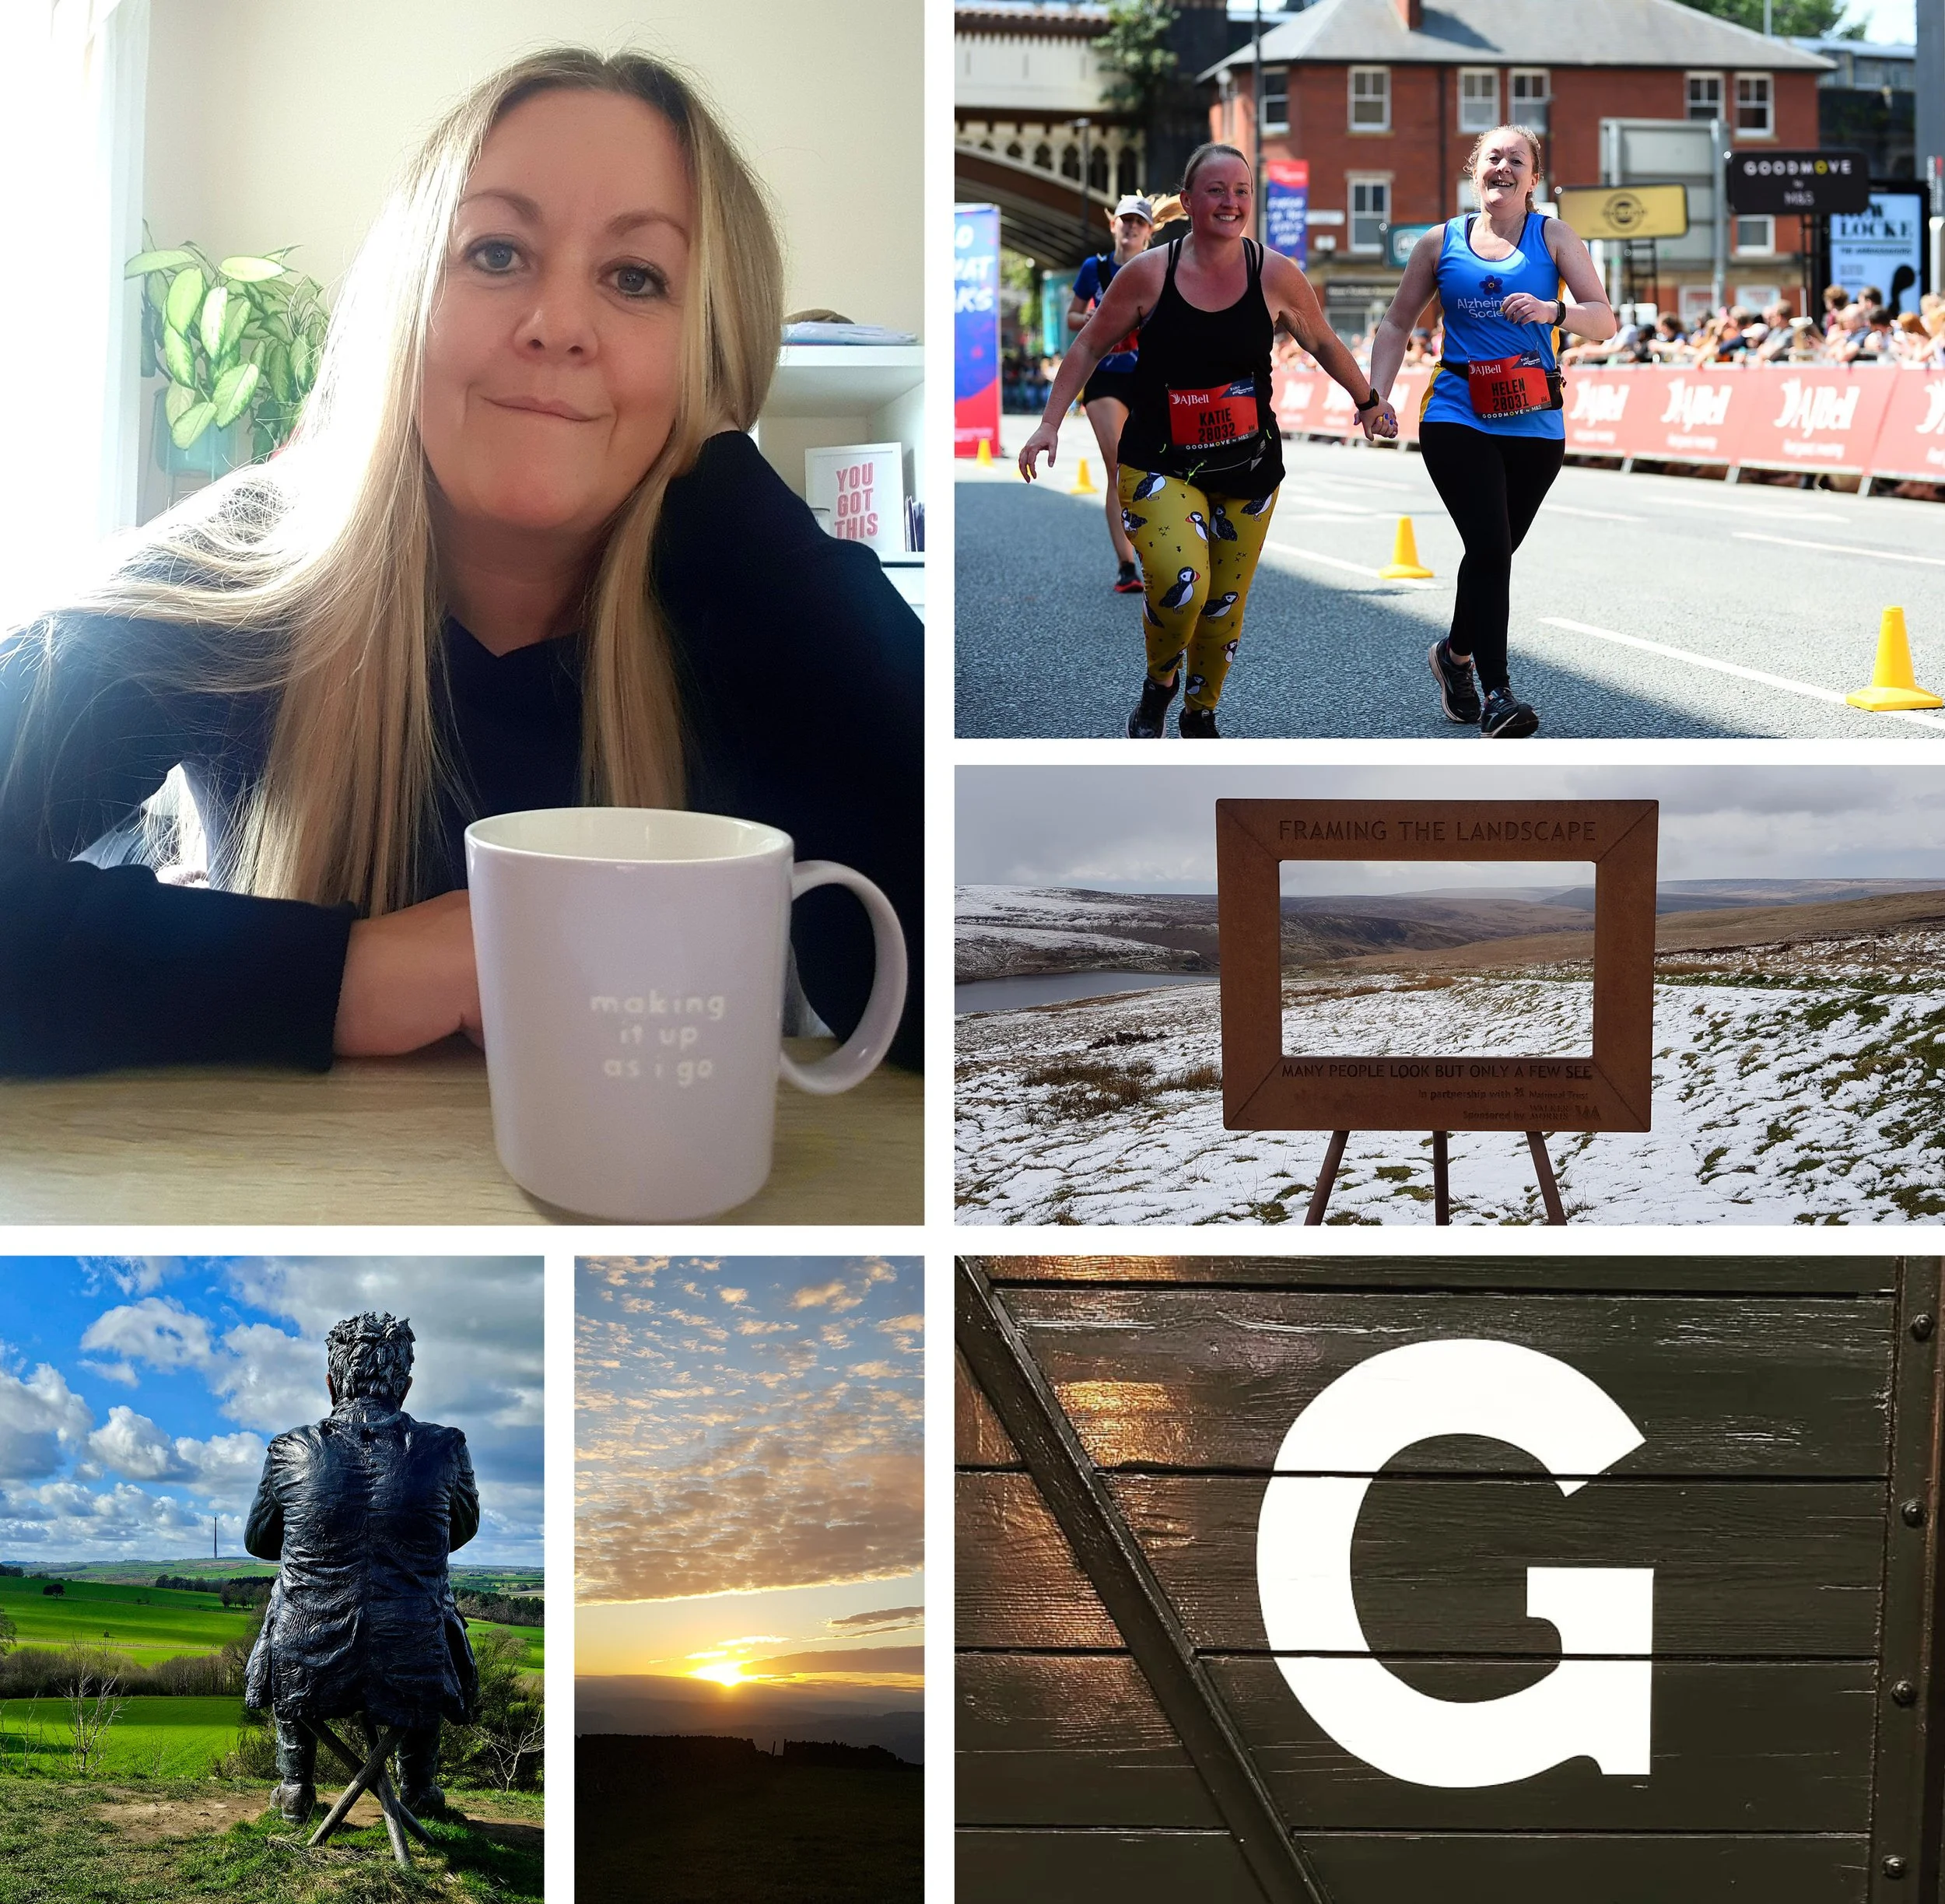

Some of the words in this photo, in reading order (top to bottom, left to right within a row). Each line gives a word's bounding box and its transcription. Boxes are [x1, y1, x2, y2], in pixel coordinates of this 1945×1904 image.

[1743, 160, 1852, 176] GOODMOVE
[1457, 297, 1503, 309] Alzheim
[1468, 308, 1505, 318] Socie
[1491, 377, 1526, 396] HELEN
[1492, 393, 1529, 412] 28031
[1199, 408, 1232, 426] KATIE
[1482, 409, 1524, 419] GOODMOVE
[1199, 423, 1236, 442] 28032
[1186, 440, 1230, 450] GOODMOVE
[836, 461, 874, 493] YOU
[837, 488, 874, 517] GOT
[834, 513, 878, 539] THIS
[1278, 819, 1387, 841] FRAMING
[1399, 820, 1446, 841] THE
[1456, 820, 1596, 841] LANDSCAPE
[591, 989, 725, 1021] making
[620, 1021, 643, 1044] it
[660, 1026, 698, 1050] up
[604, 1059, 640, 1076] as
[655, 1055, 662, 1078] i
[677, 1059, 713, 1087] go
[1282, 1064, 1323, 1078] MANY
[1330, 1064, 1385, 1078] PEOPLE
[1390, 1064, 1430, 1078] LOOK
[1435, 1064, 1466, 1078] BUT
[1471, 1064, 1509, 1078] ONLY
[1513, 1064, 1526, 1078] A
[1530, 1064, 1561, 1078] FEW
[1566, 1065, 1593, 1079] SEE
[1430, 1089, 1487, 1100] partnership
[1490, 1089, 1511, 1099] with
[1529, 1090, 1566, 1099] National
[1568, 1090, 1589, 1099] Trust
[1463, 1110, 1511, 1120] Sponsored
[1513, 1110, 1526, 1120] by
[1256, 1338, 1654, 1788] G
